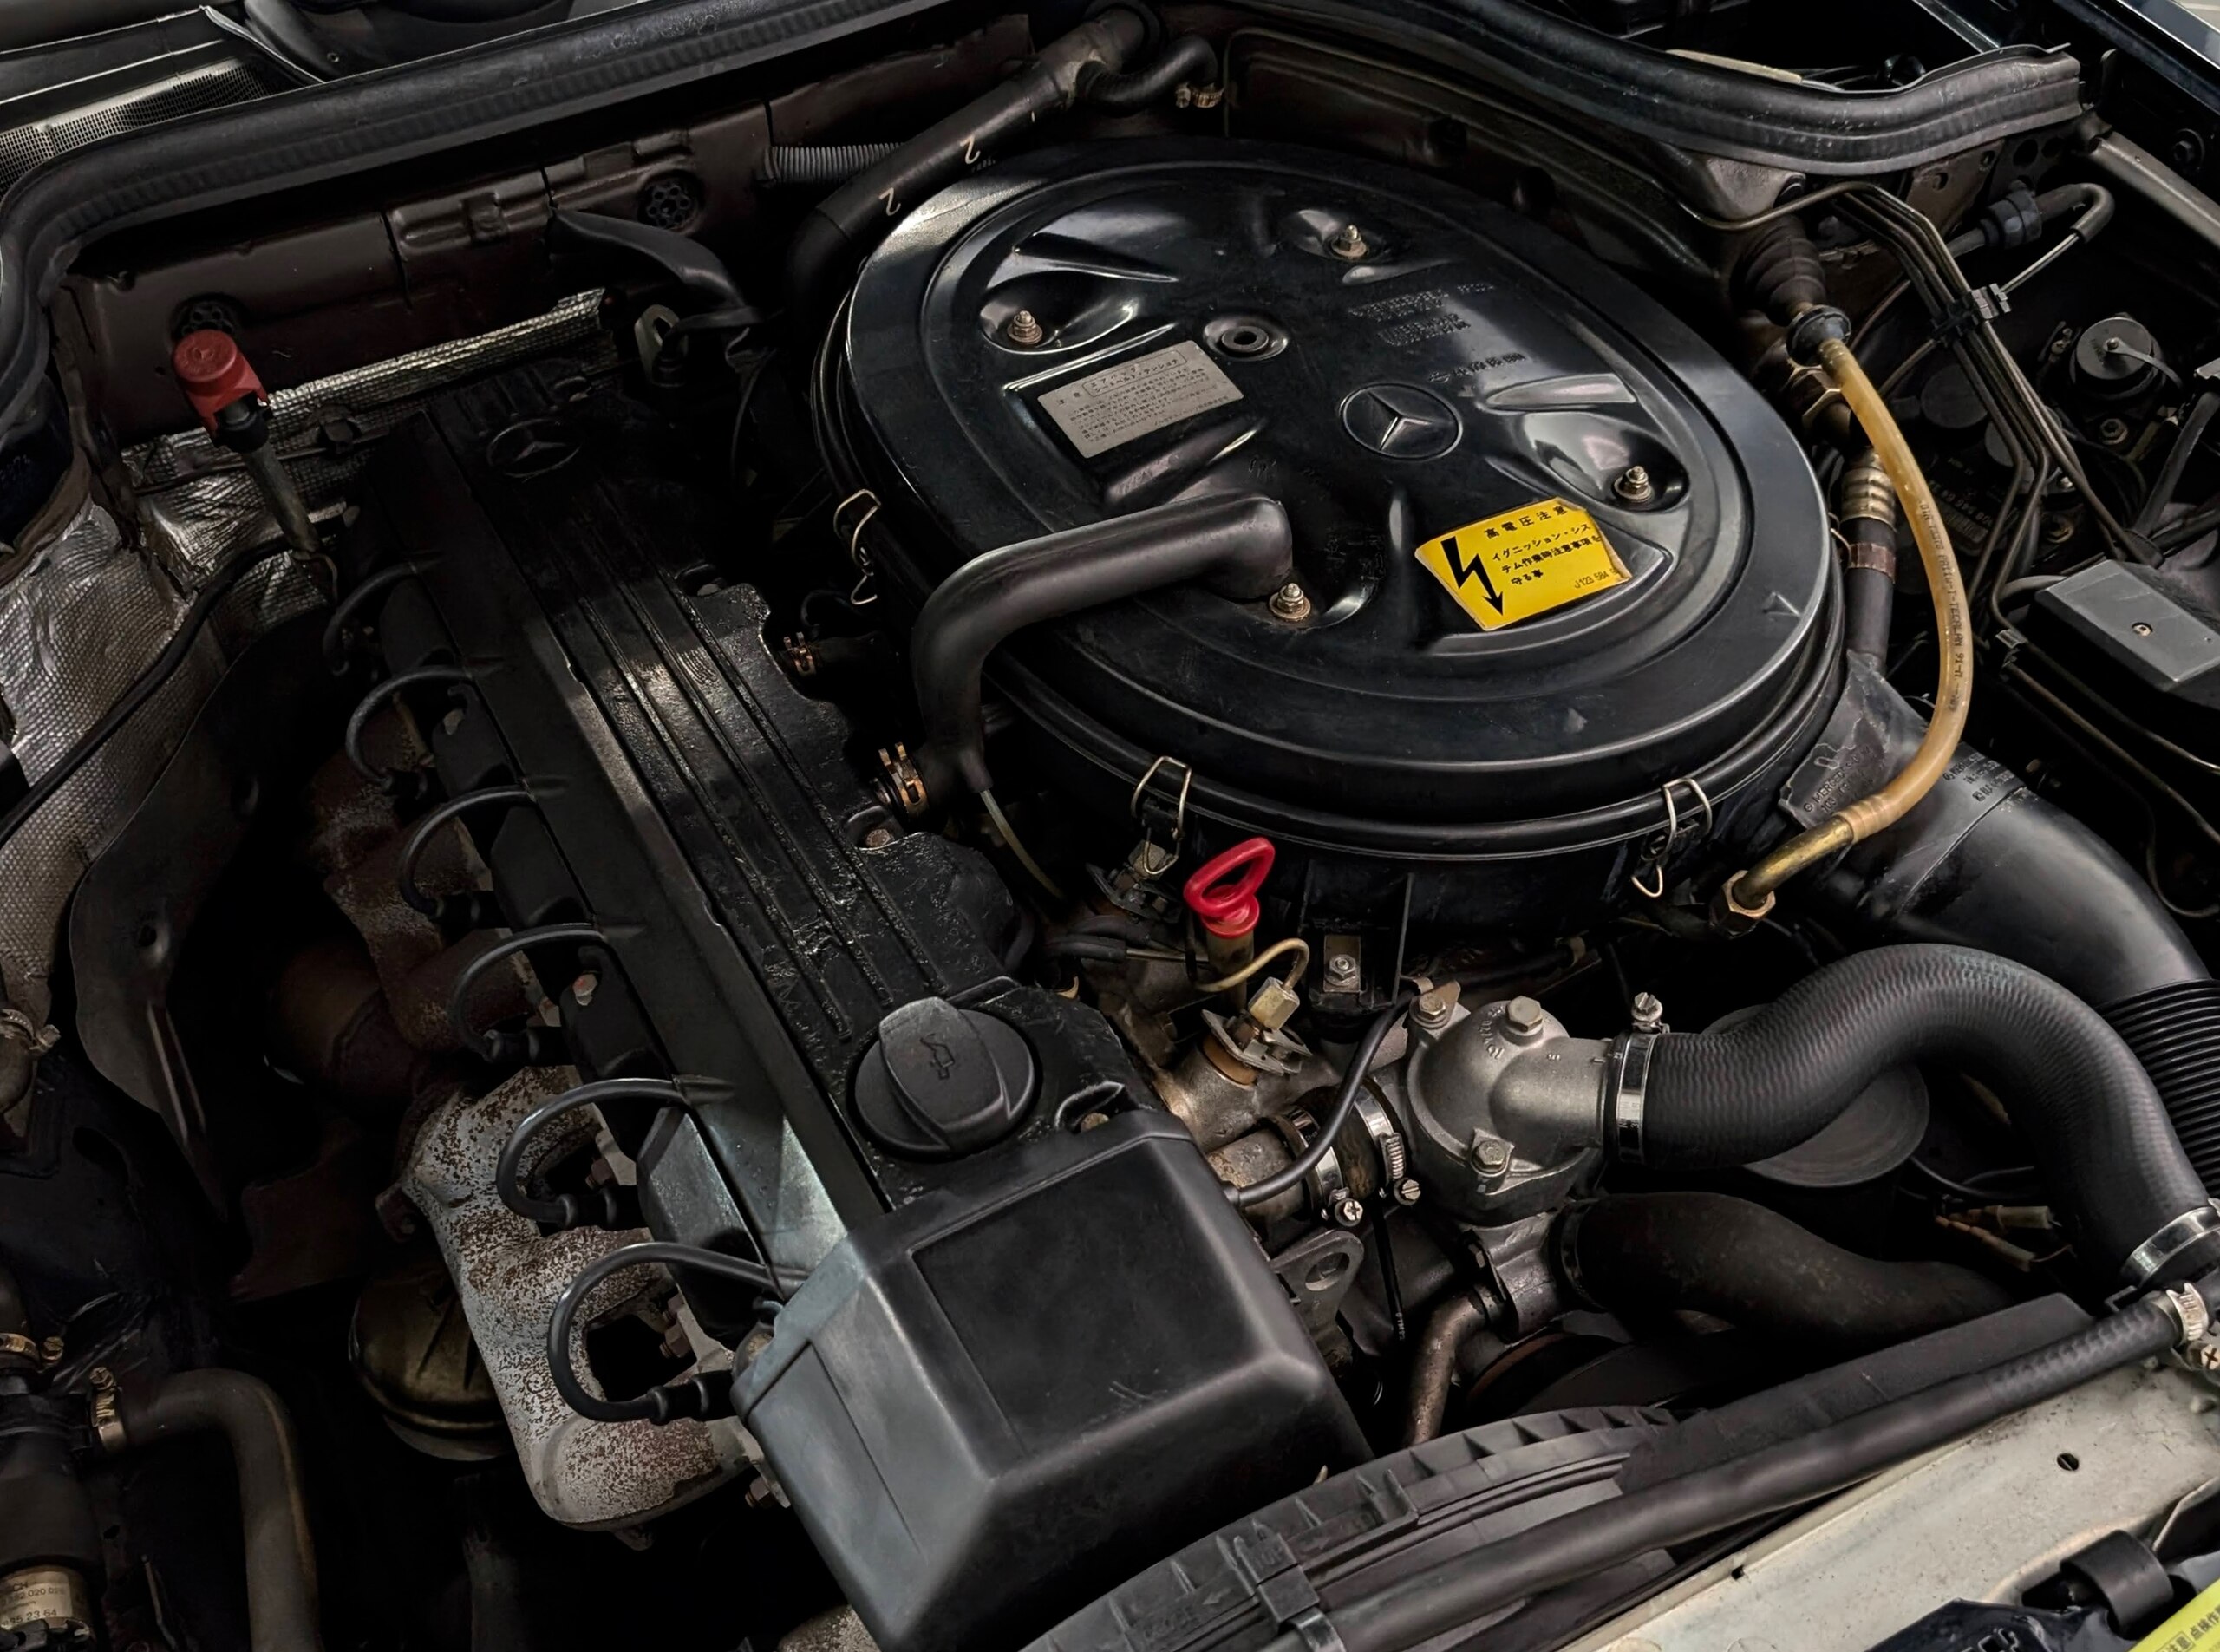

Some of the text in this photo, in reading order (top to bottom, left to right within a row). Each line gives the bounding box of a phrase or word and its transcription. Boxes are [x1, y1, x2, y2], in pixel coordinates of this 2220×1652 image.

[1484, 506, 1568, 539] 高電圧注意
[1511, 569, 1544, 586] 守る事
